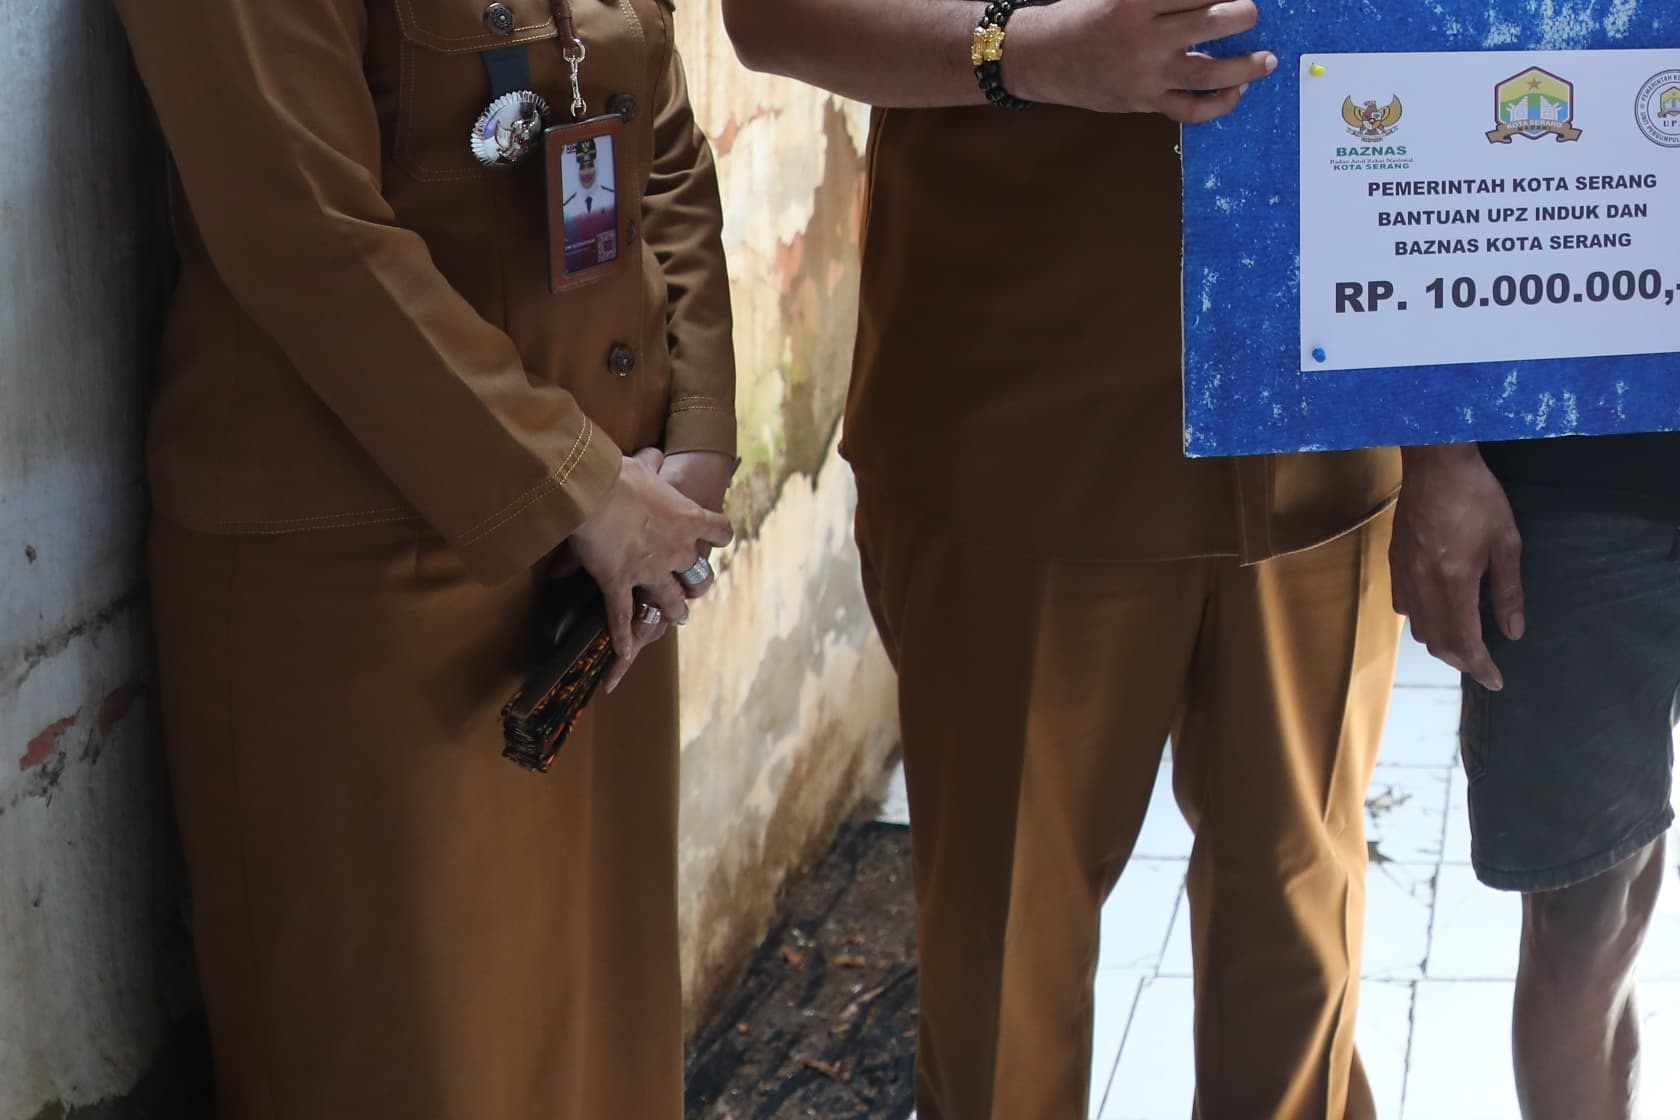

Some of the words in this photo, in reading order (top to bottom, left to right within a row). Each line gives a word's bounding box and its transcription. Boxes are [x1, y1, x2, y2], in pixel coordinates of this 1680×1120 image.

[1336, 146, 1407, 157] BAZNAS
[1368, 178, 1505, 197] PEMERINTAH
[1512, 177, 1569, 193] KOTA
[1575, 174, 1658, 191] SERANG
[1378, 208, 1480, 227] BANTUAN
[1487, 207, 1528, 223] UPZ
[1535, 205, 1600, 222] INDUK
[1606, 203, 1648, 219] DAN
[1394, 238, 1479, 256] BAZNAS
[1486, 236, 1543, 253] KOTA
[1549, 233, 1632, 250] SERANG
[1335, 280, 1407, 313] RP.
